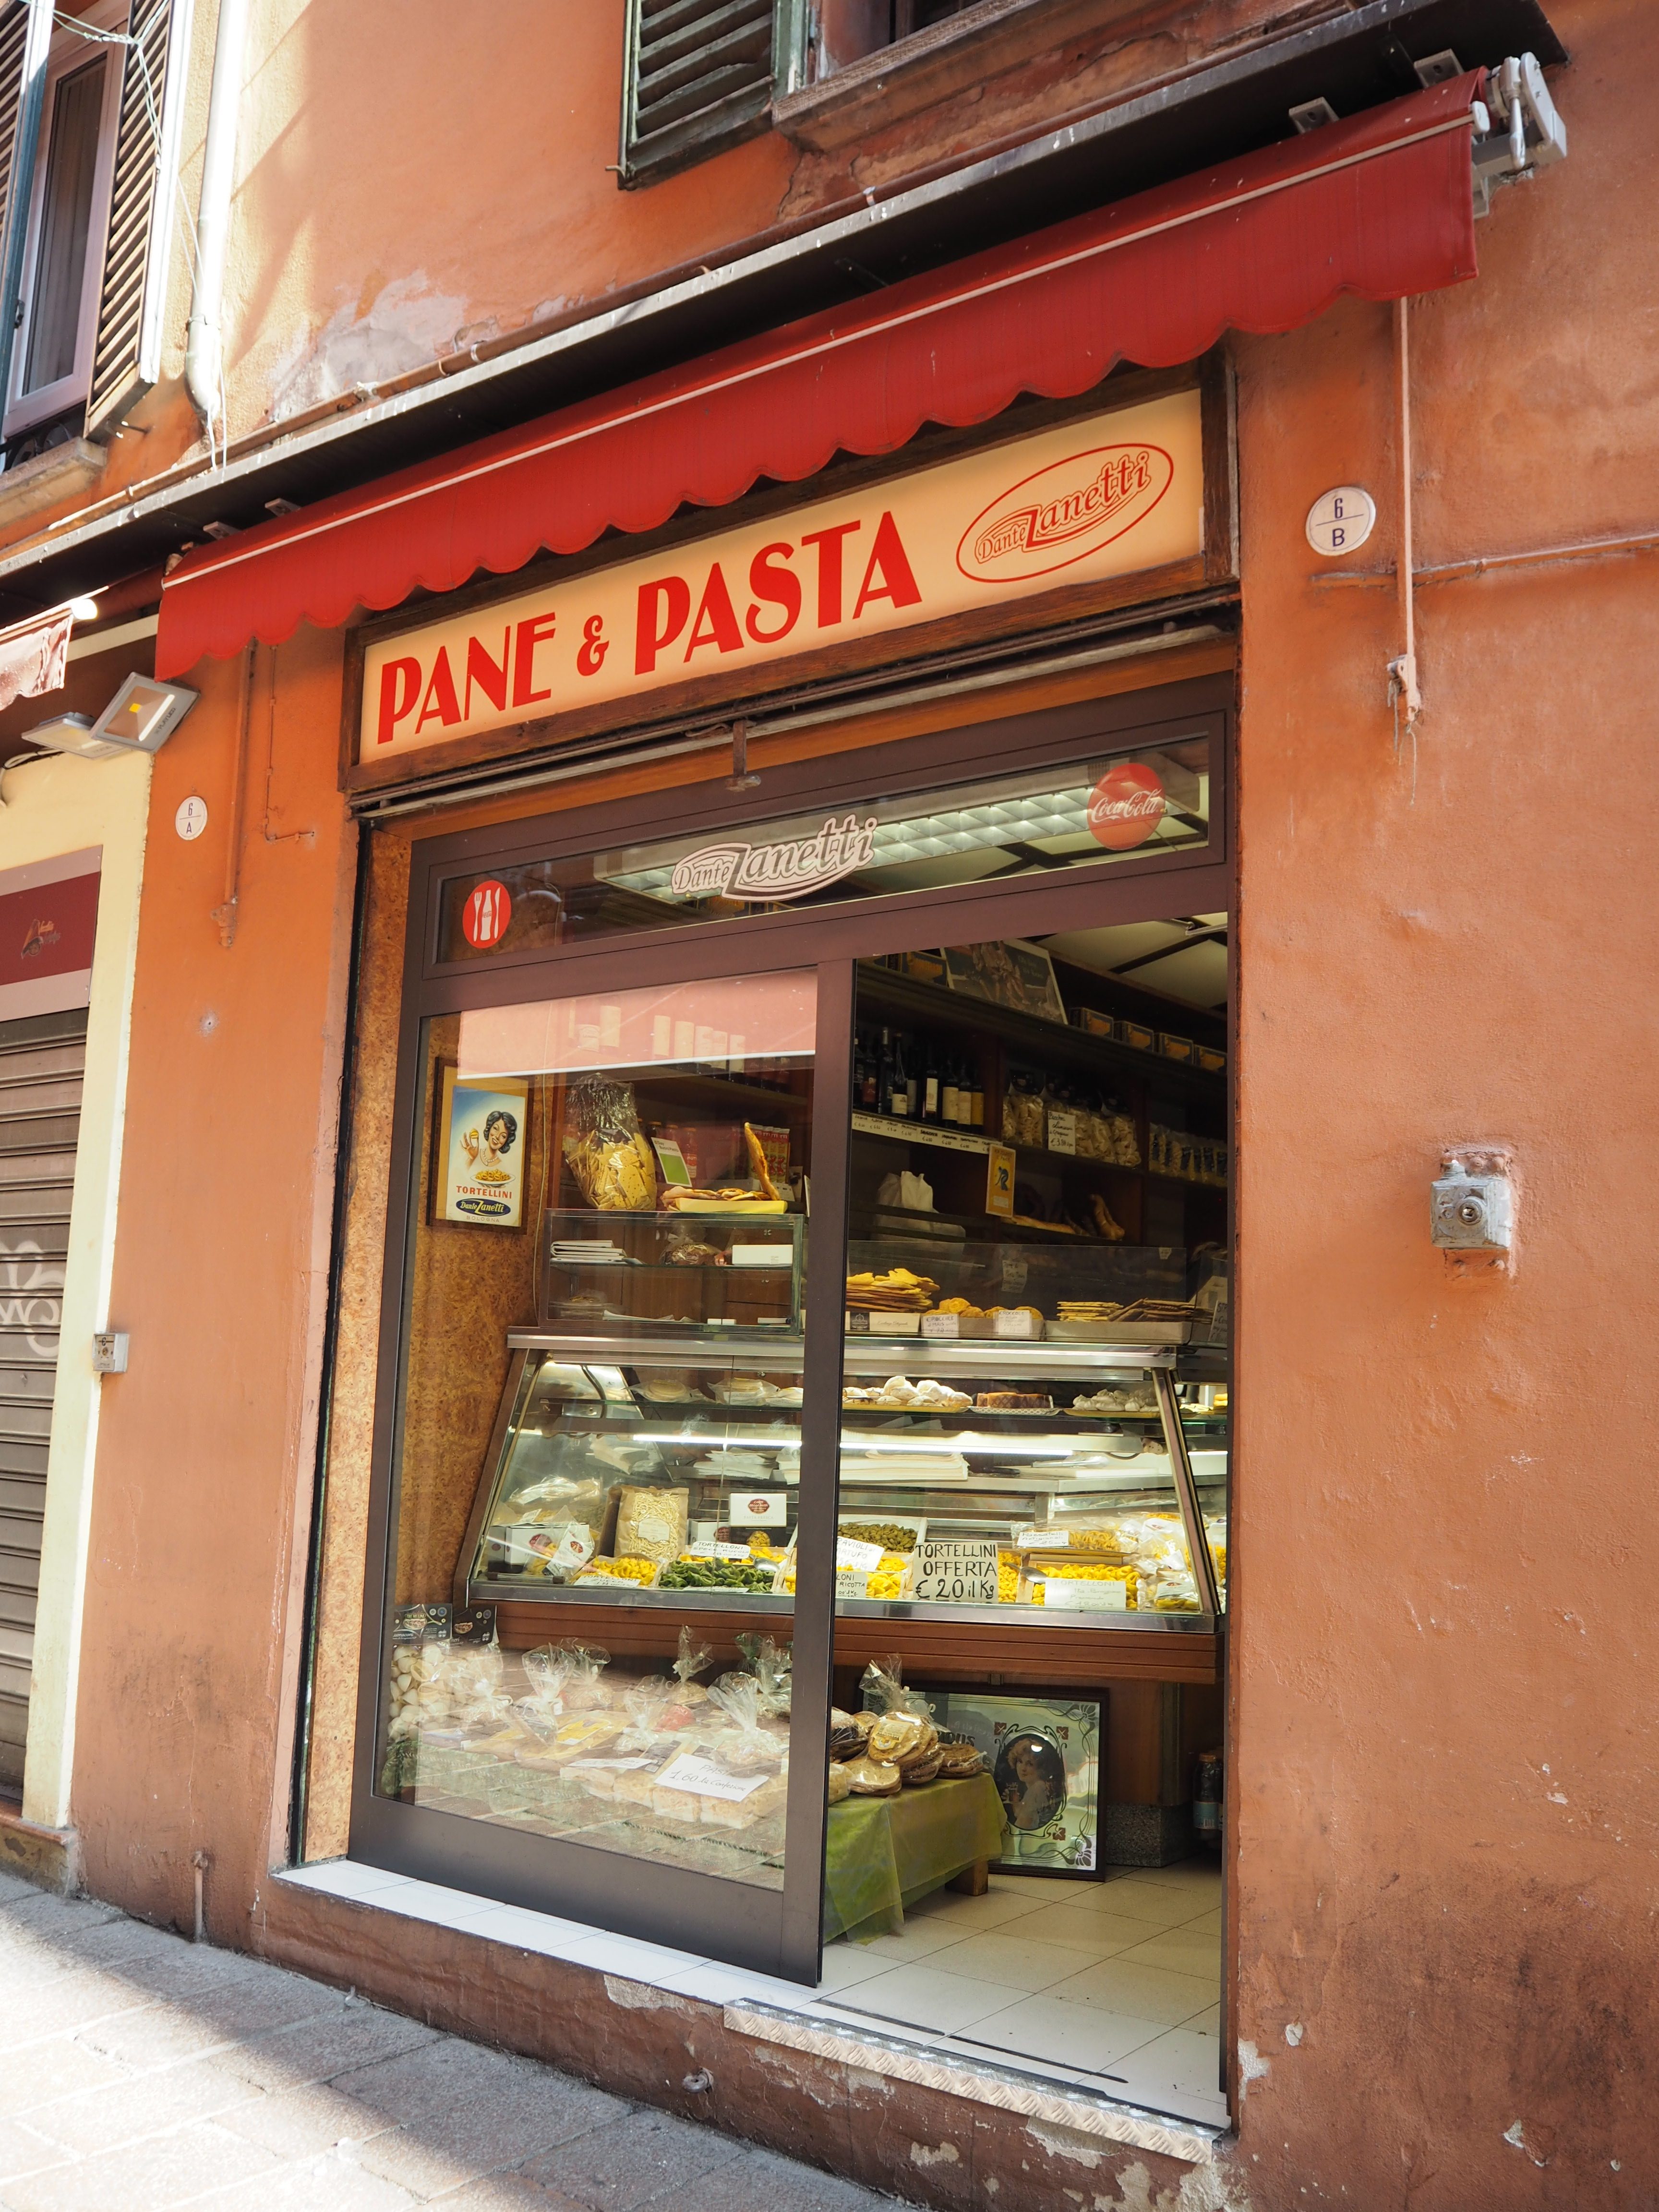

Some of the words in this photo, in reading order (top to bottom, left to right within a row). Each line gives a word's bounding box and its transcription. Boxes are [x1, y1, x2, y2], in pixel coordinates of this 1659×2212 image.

[977, 523, 1026, 561] Dante
[1022, 451, 1151, 553] Zanetti
[1334, 497, 1343, 519] 6
[1332, 528, 1345, 547] B
[377, 612, 556, 745] PANE
[577, 614, 610, 677] &
[635, 510, 923, 676] PASTA
[188, 802, 193, 816] 6
[186, 821, 192, 834] A
[673, 860, 730, 893] Dante
[721, 815, 878, 901] Zanetti
[456, 1185, 512, 1199] TORTELLINI
[460, 1201, 478, 1210] Dante
[474, 1201, 505, 1214] Zanetti
[697, 1541, 744, 1550] TORTELLONI
[915, 1543, 997, 1558] TORTELLINI
[837, 1548, 867, 1559] ARTUFO
[923, 1561, 997, 1577] OFFERTA
[915, 1579, 930, 1599] €
[936, 1578, 964, 1599] 20
[980, 1579, 995, 1599] Kg
